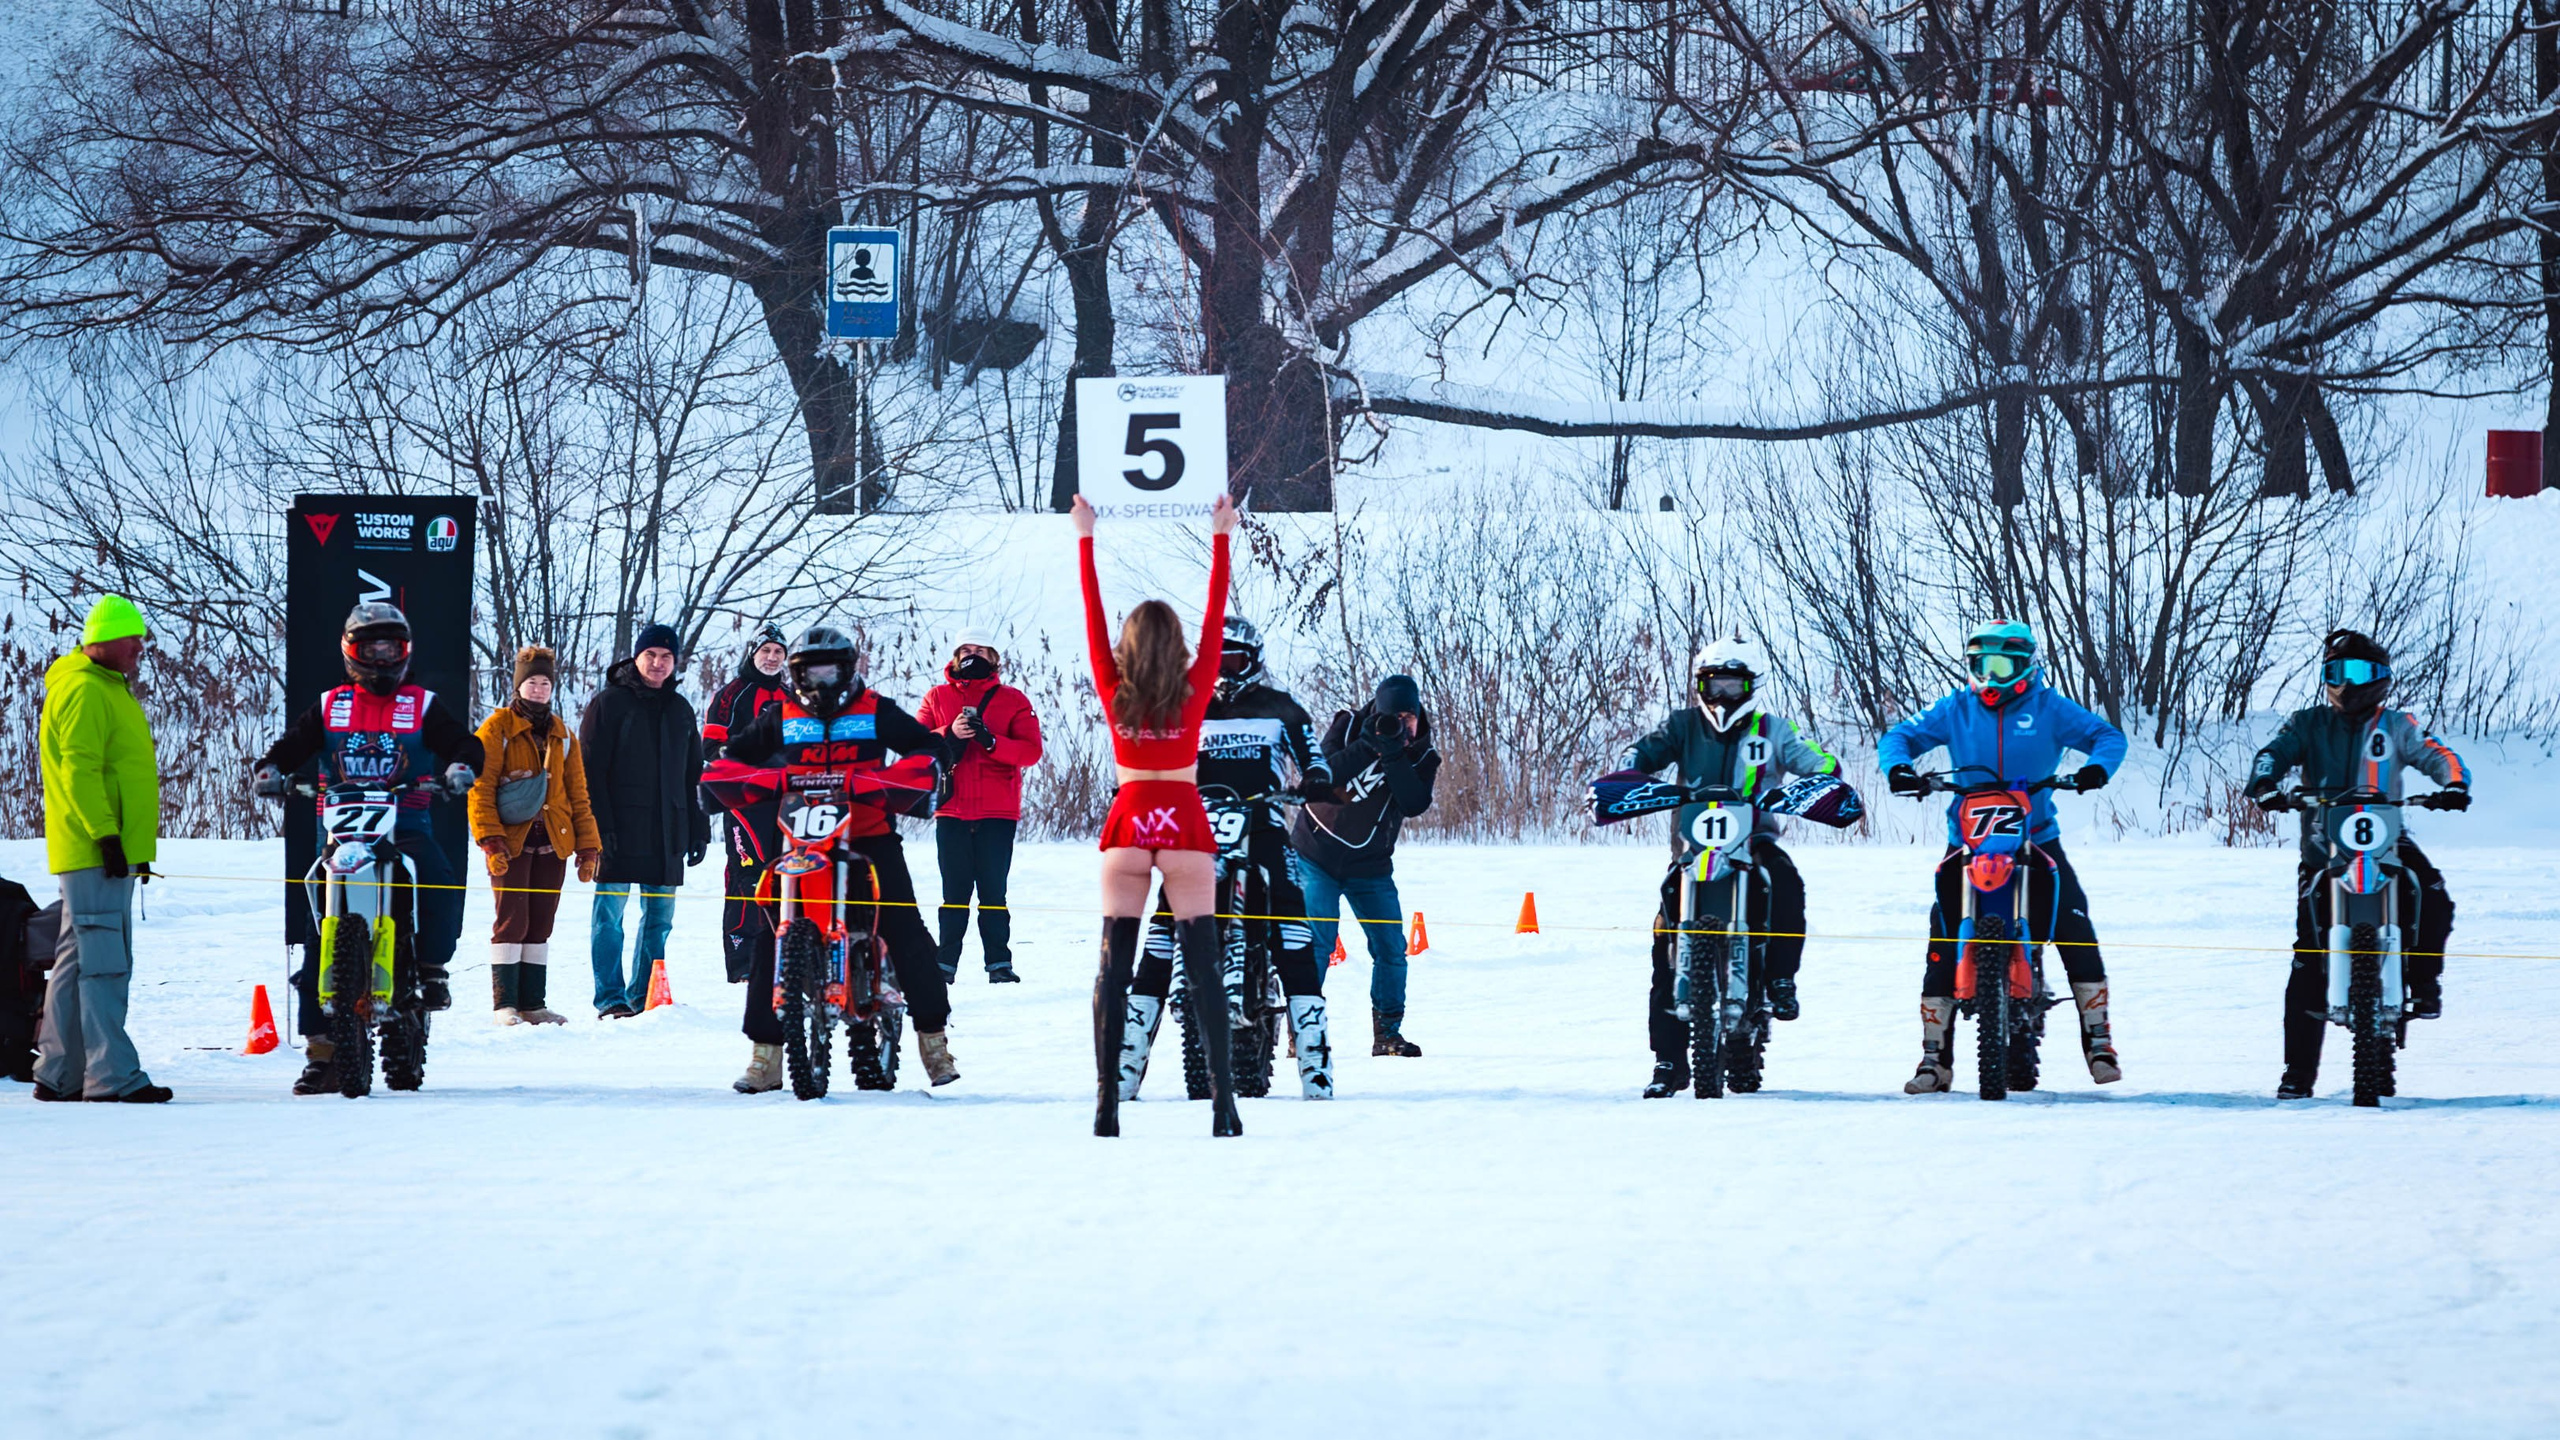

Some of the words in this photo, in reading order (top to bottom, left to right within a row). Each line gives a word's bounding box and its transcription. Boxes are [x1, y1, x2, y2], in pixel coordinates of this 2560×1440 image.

[1122, 412, 1185, 491] 5
[354, 513, 414, 527] CUSTOM
[1090, 503, 1215, 519] MX-SPEEDWA
[358, 526, 411, 540] WORKS
[1747, 741, 1765, 761] 11
[2371, 733, 2386, 757] 8
[331, 805, 390, 833] 27
[788, 804, 839, 838] 16
[1132, 807, 1180, 839] MX
[1702, 816, 1728, 840] 11
[1969, 806, 2025, 838] 72
[2354, 817, 2374, 845] 8
